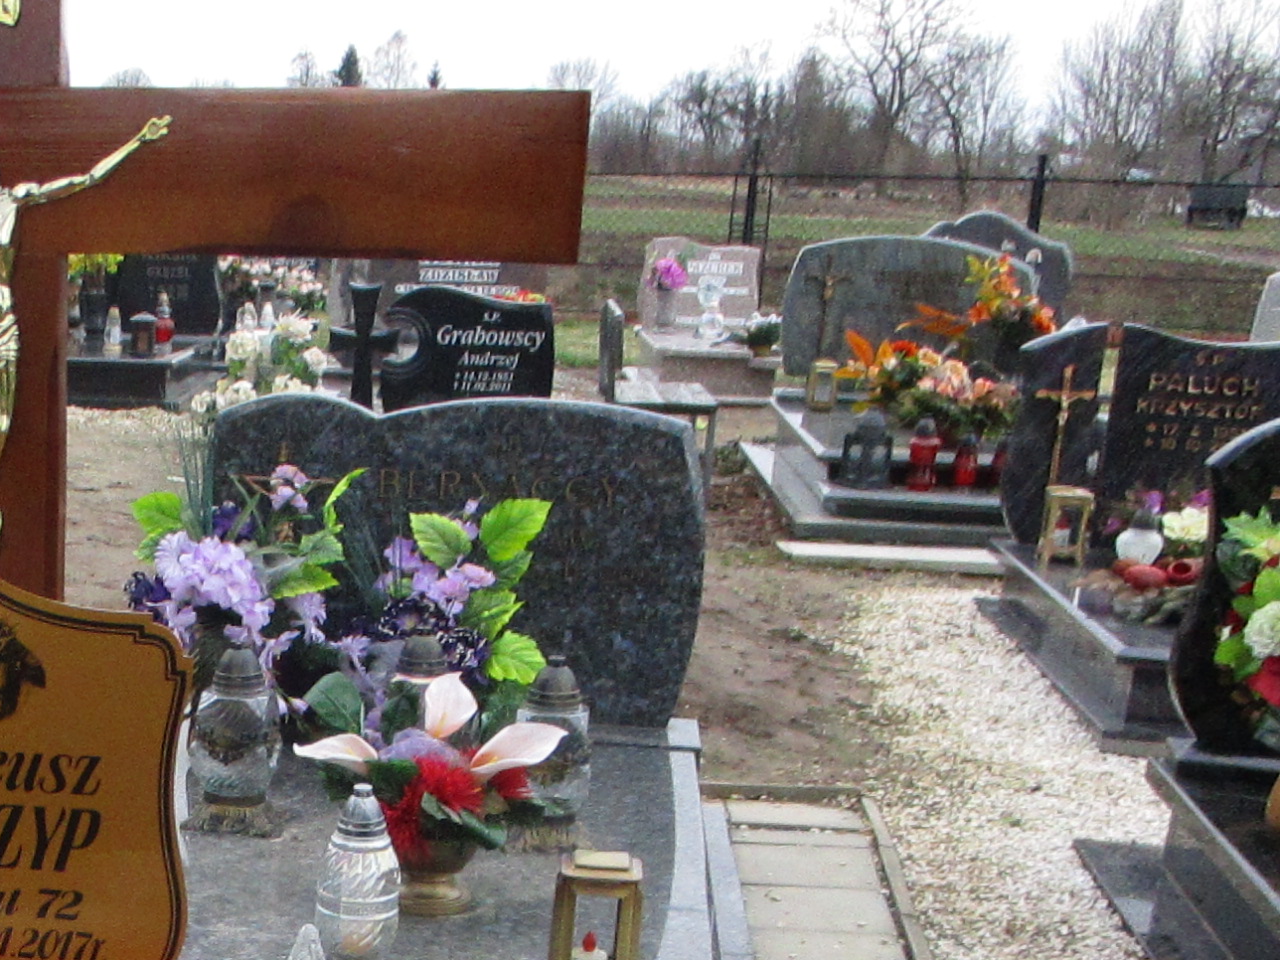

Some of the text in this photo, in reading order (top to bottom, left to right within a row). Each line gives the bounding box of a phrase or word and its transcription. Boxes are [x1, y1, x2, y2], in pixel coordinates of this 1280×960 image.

[436, 324, 546, 352] Grabowscy
[457, 351, 520, 370] Andrzej
[1148, 372, 1260, 397] PALUCH
[35, 888, 84, 921] 72
